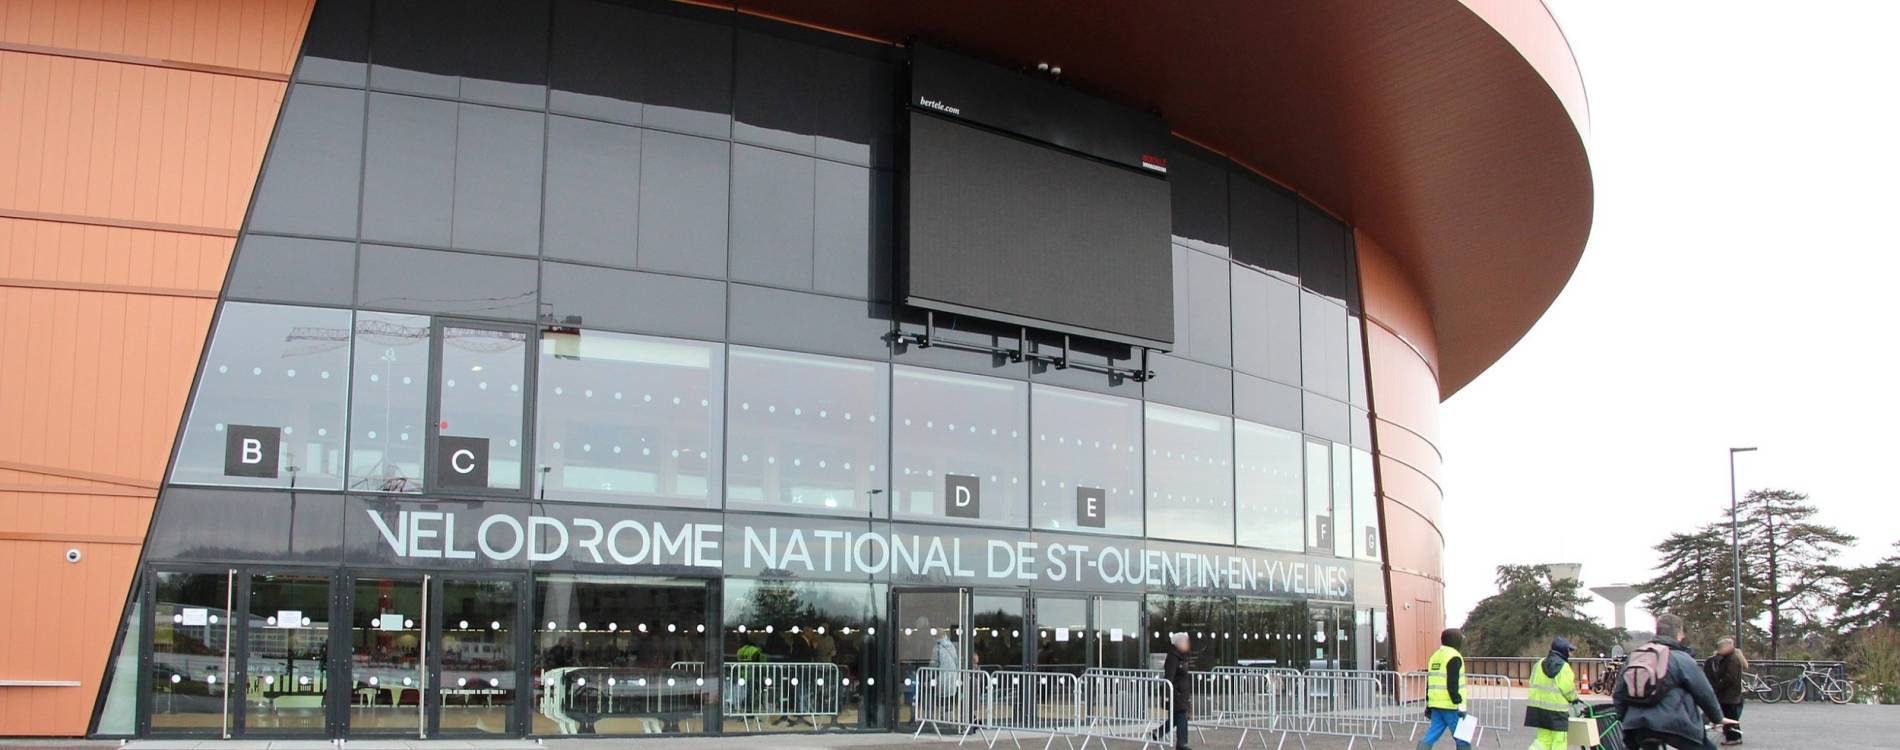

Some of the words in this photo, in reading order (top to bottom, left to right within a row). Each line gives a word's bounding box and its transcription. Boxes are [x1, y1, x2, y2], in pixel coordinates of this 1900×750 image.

[920, 96, 960, 115] bertele.com
[242, 438, 263, 464] B
[451, 449, 476, 474] C
[955, 485, 971, 507] D
[1087, 497, 1097, 517] E
[1320, 523, 1327, 540] F
[1368, 533, 1375, 549] G
[366, 509, 723, 567] VELODROME
[744, 526, 975, 577] NATIONAL
[987, 539, 1038, 580] DE
[1046, 542, 1348, 597] ST-QUENTIN-EN-YVELINES
